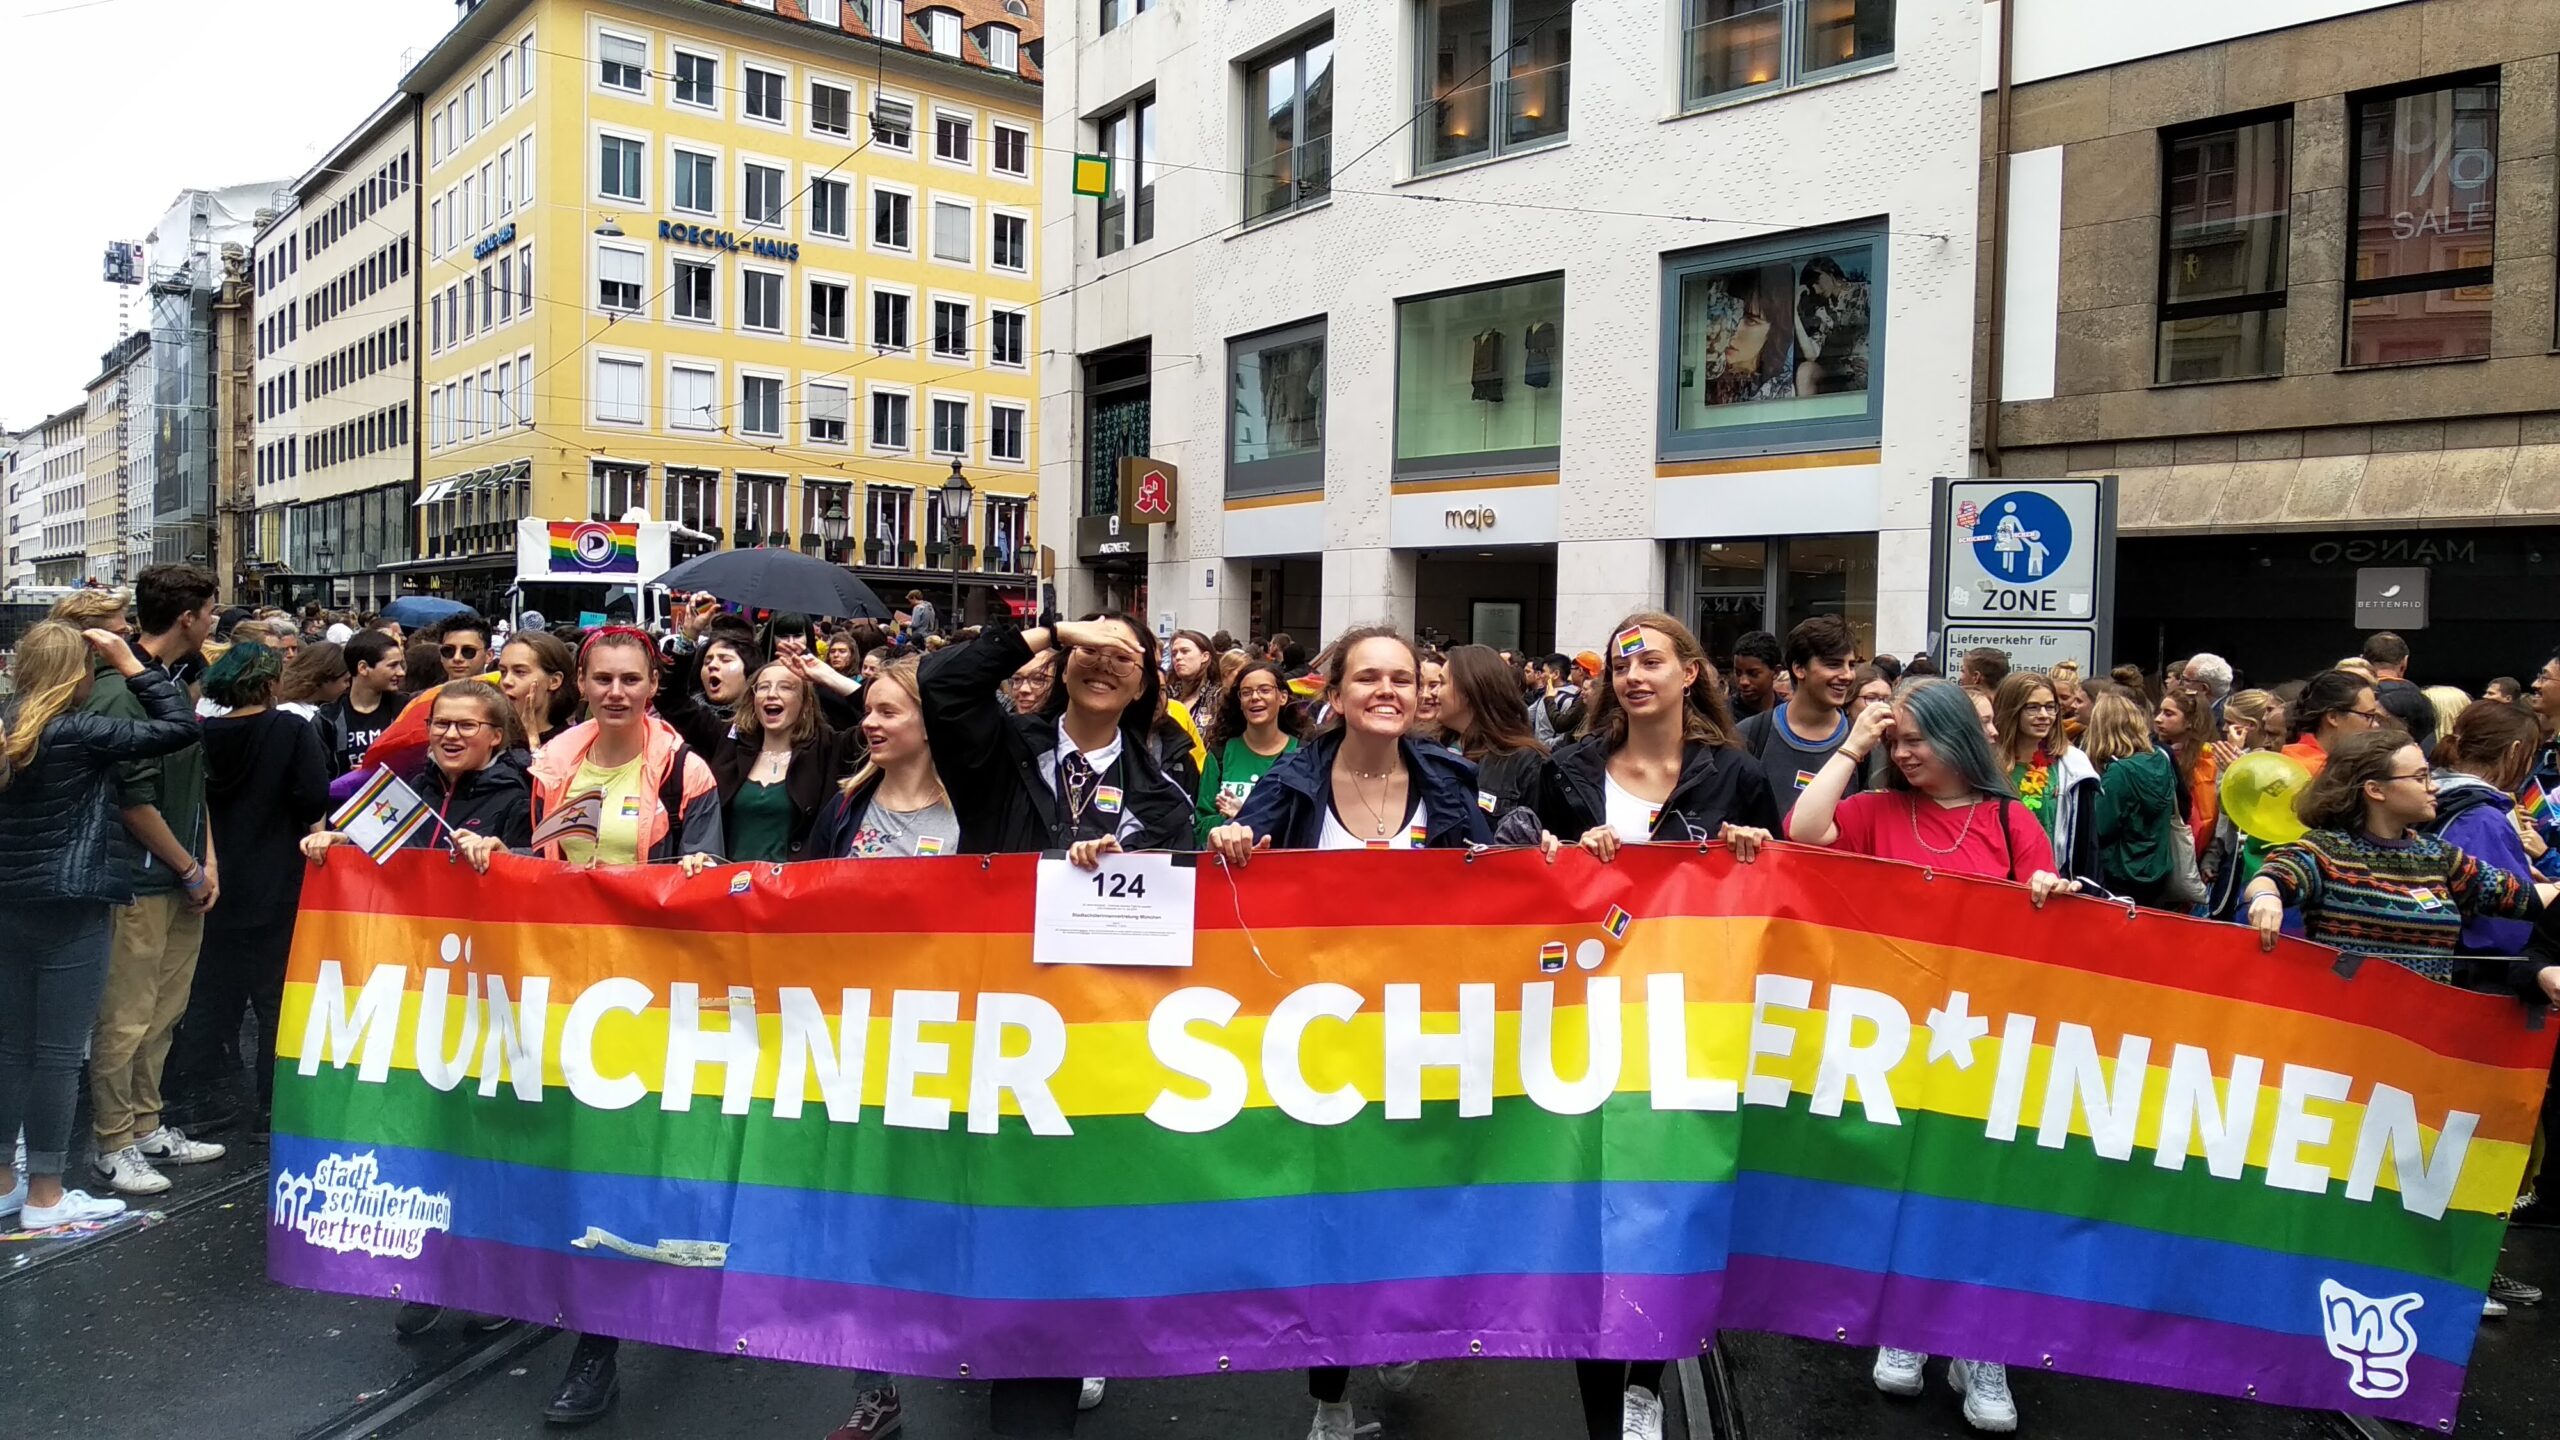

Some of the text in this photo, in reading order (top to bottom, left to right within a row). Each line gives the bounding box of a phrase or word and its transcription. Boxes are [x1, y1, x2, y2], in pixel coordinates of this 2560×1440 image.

[2391, 201, 2491, 240] SALE
[658, 220, 800, 261] ROECKL-HAUS
[1445, 503, 1496, 532] maje
[1098, 541, 1131, 554] AIGNER
[1982, 589, 2058, 612] ZONE
[1950, 634, 2058, 646] Lieferverkehr für
[1092, 872, 1146, 898] 124
[297, 933, 1074, 1137] MÜNCHNER
[318, 1160, 373, 1189] stadt
